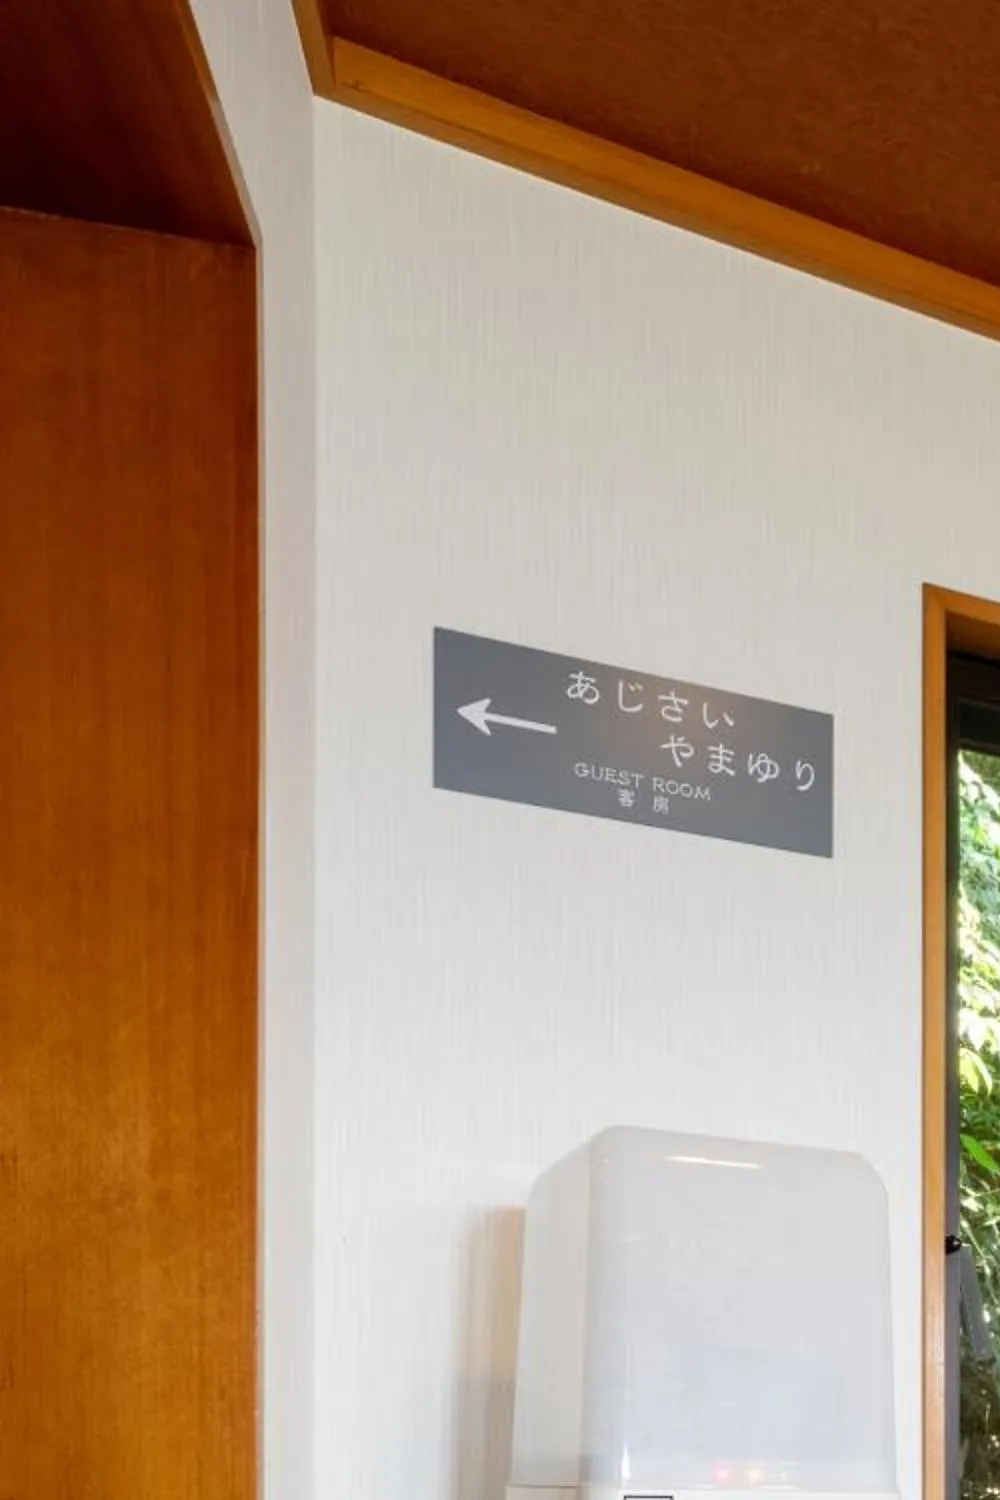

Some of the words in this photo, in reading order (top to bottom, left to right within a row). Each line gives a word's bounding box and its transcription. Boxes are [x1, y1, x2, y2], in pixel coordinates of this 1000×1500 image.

[566, 670, 736, 729] あじさい
[574, 761, 645, 789] GUEST
[652, 776, 711, 801] ROOM
[659, 734, 815, 792] やまゆり
